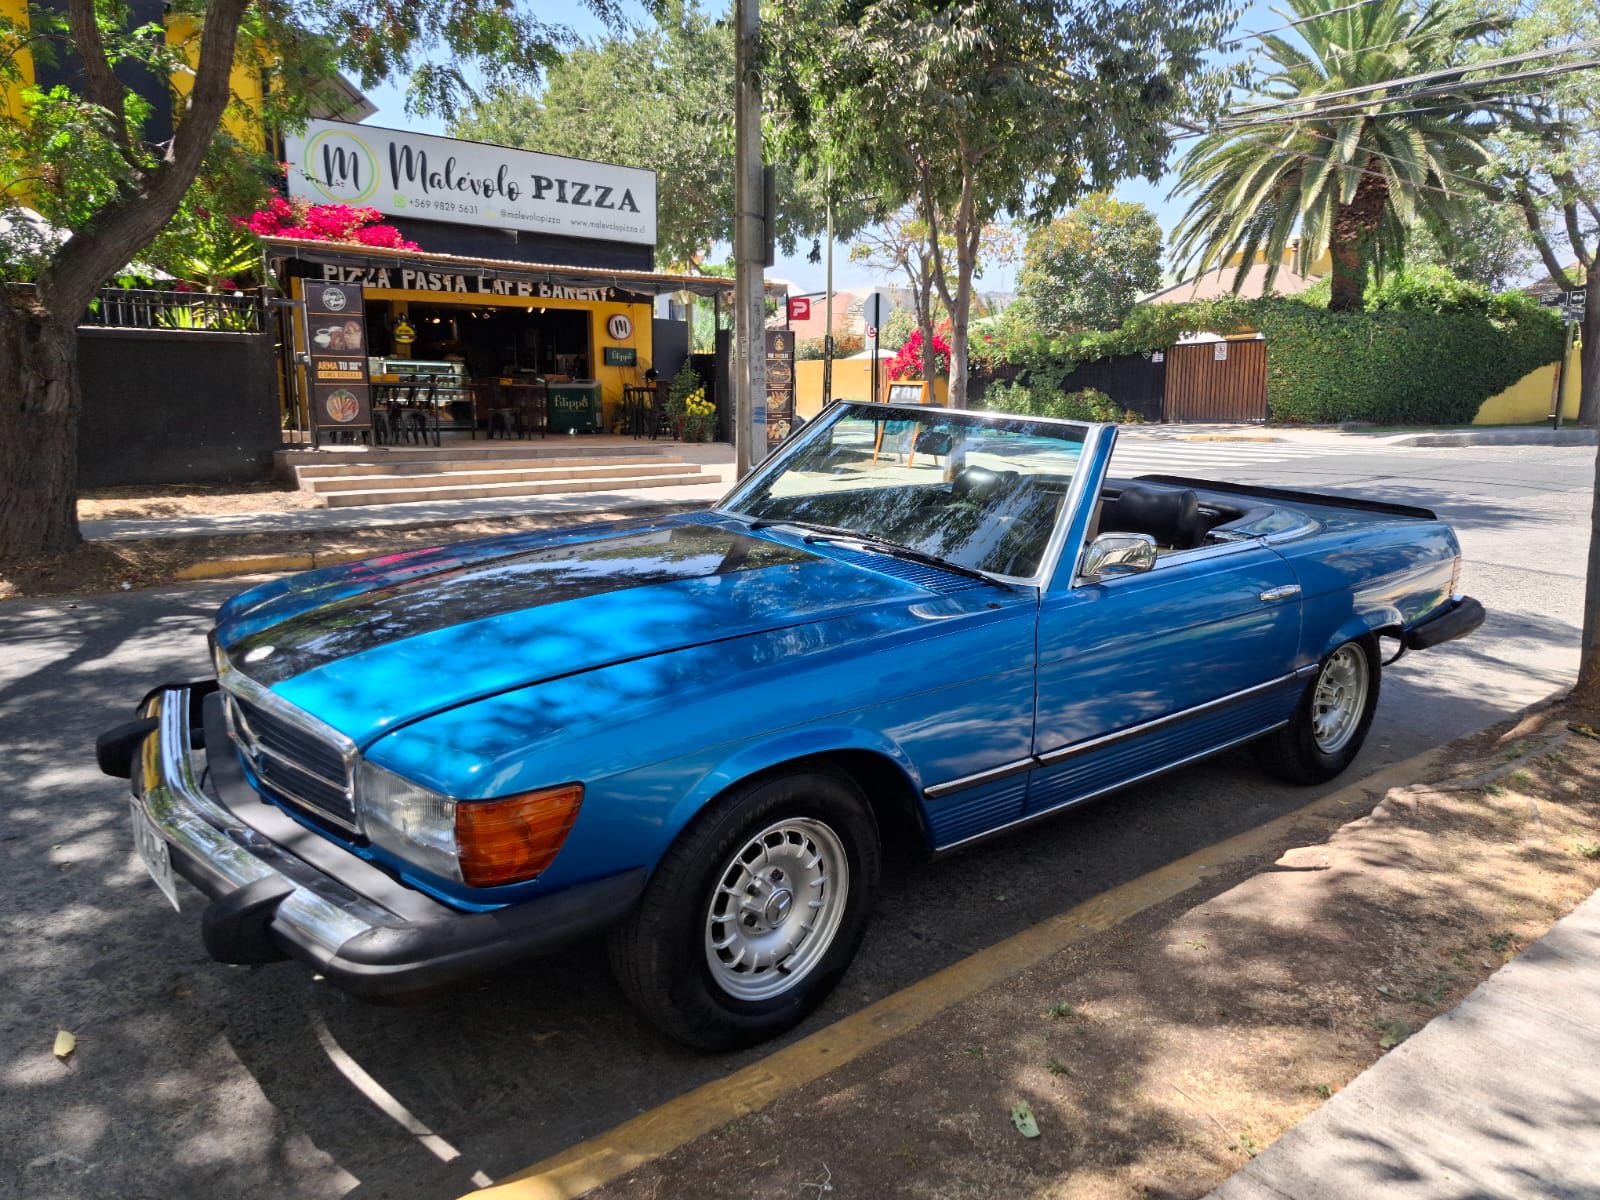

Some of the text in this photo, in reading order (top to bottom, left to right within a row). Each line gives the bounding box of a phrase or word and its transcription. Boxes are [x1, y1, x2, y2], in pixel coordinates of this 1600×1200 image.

[530, 174, 641, 214] PIZZA
[409, 198, 479, 215] +569 9829 5631
[500, 208, 561, 225] @malevolopizza
[323, 263, 391, 289] PIZZA
[402, 269, 467, 293] PASTA
